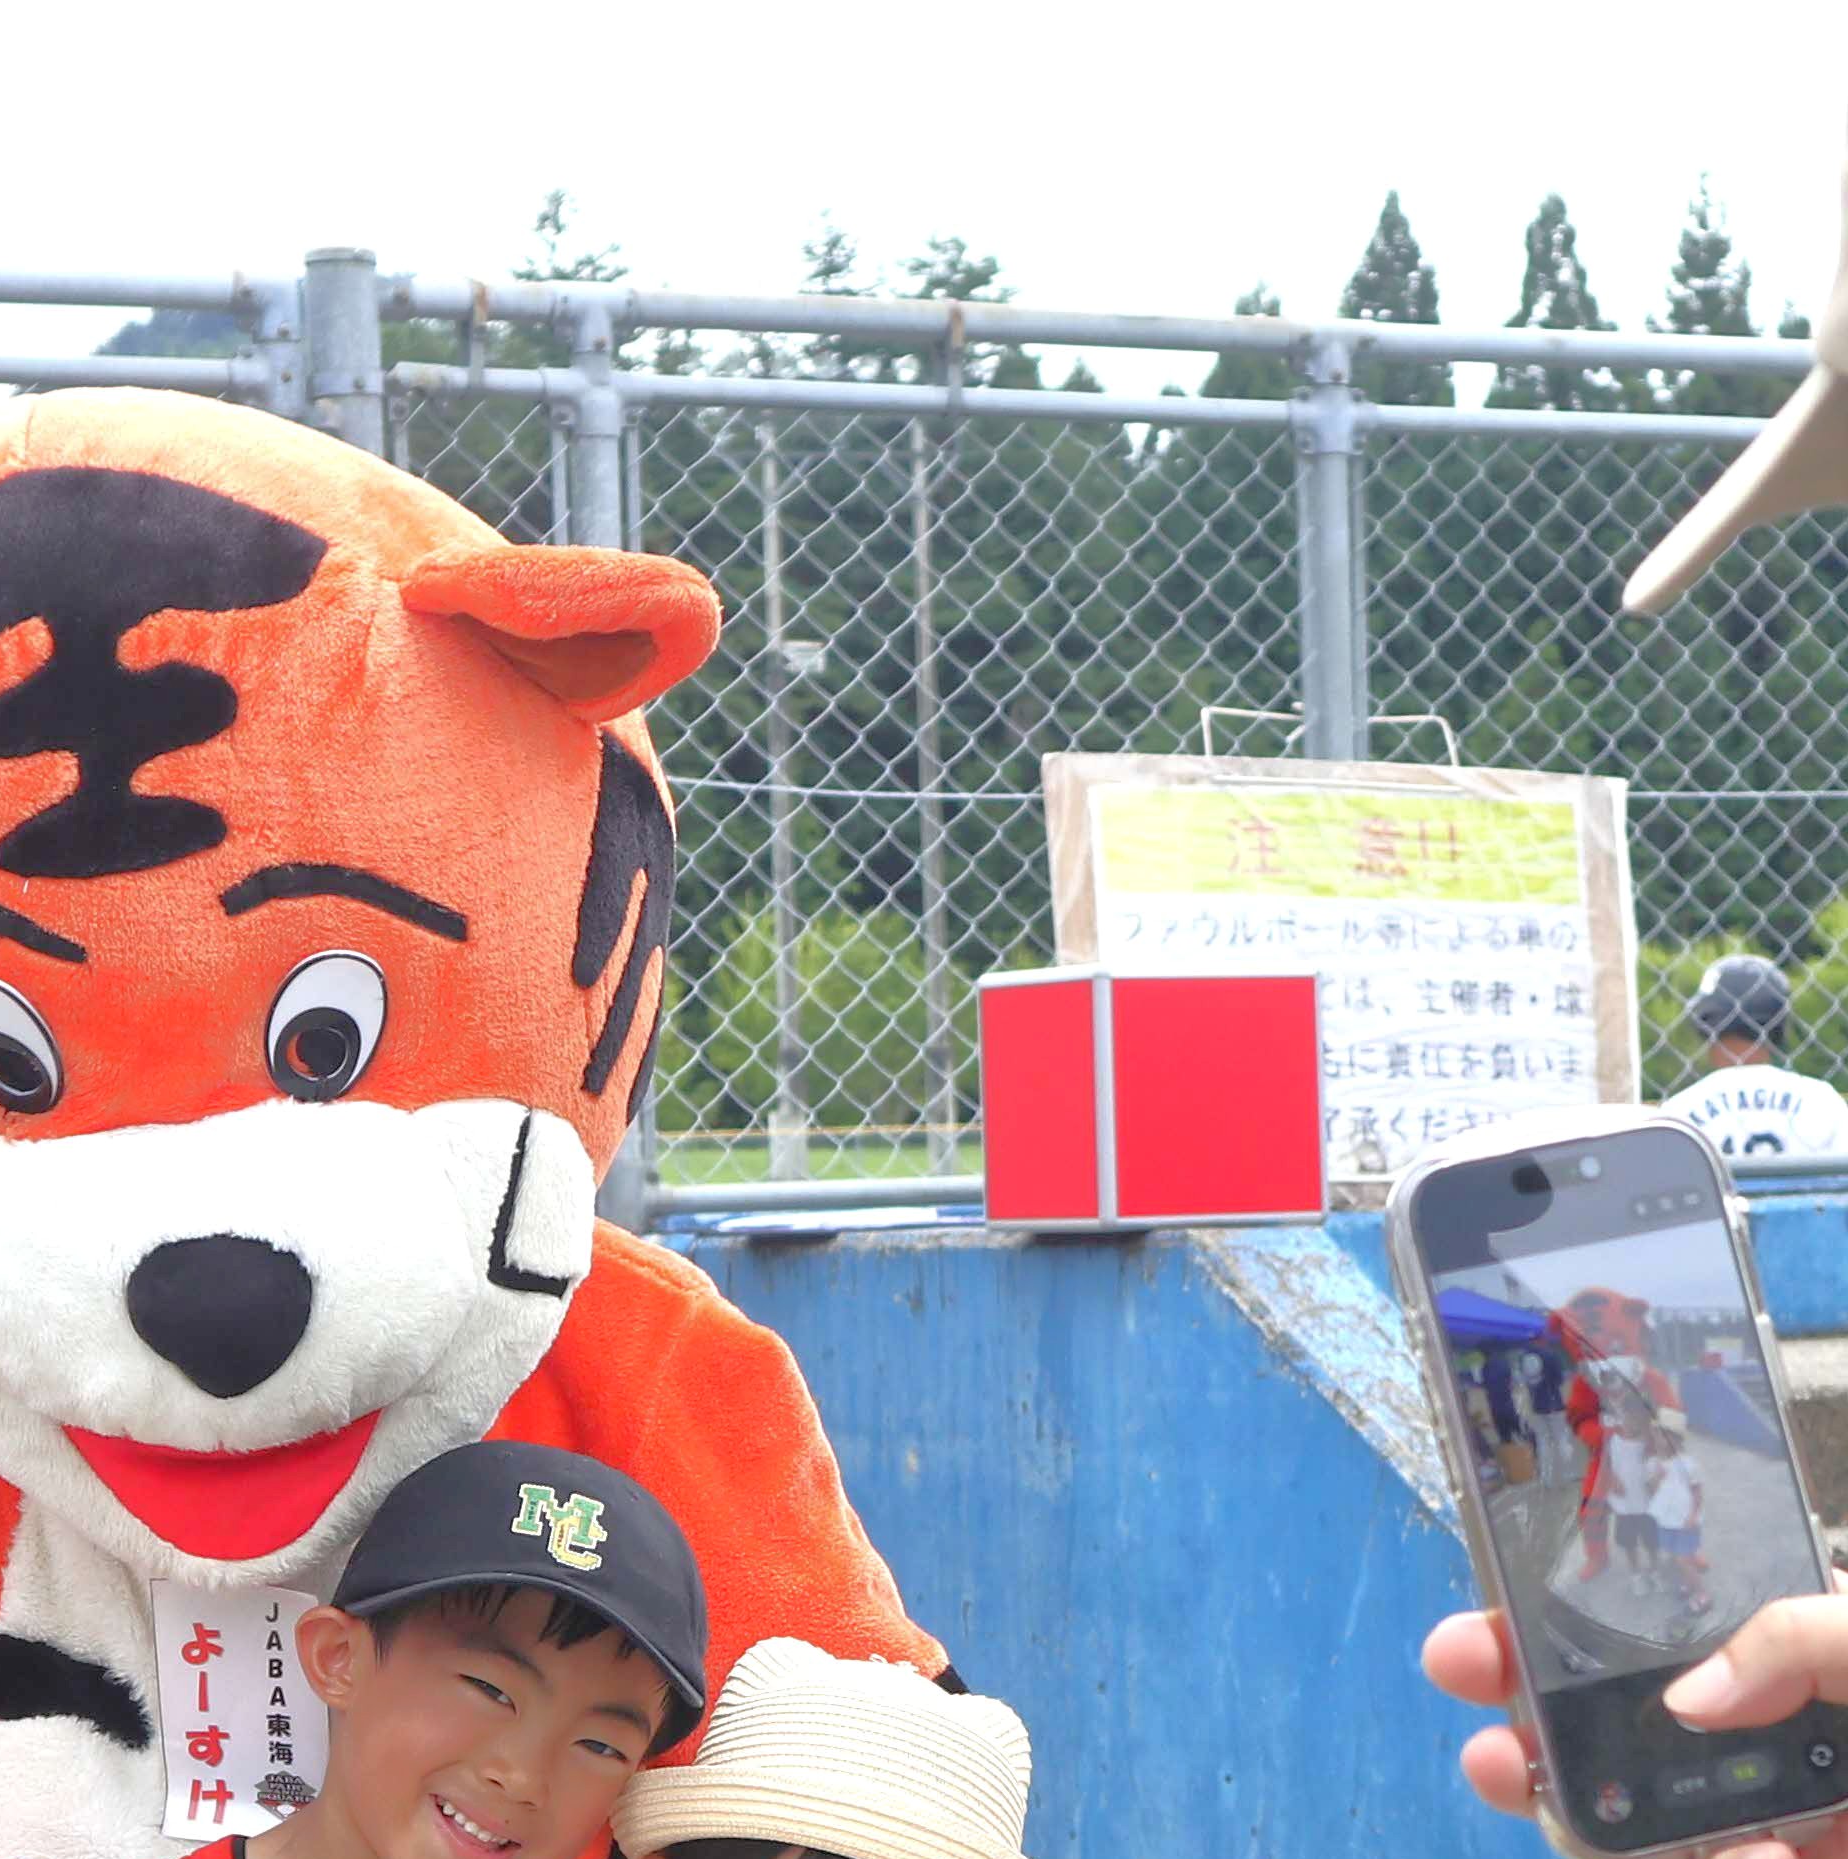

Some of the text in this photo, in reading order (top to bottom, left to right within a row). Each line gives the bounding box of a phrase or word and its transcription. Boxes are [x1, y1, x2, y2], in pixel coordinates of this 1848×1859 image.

[511, 1483, 608, 1571] MC
[181, 1622, 235, 1825] よーすけ
[265, 1602, 294, 1766] JABA東海
